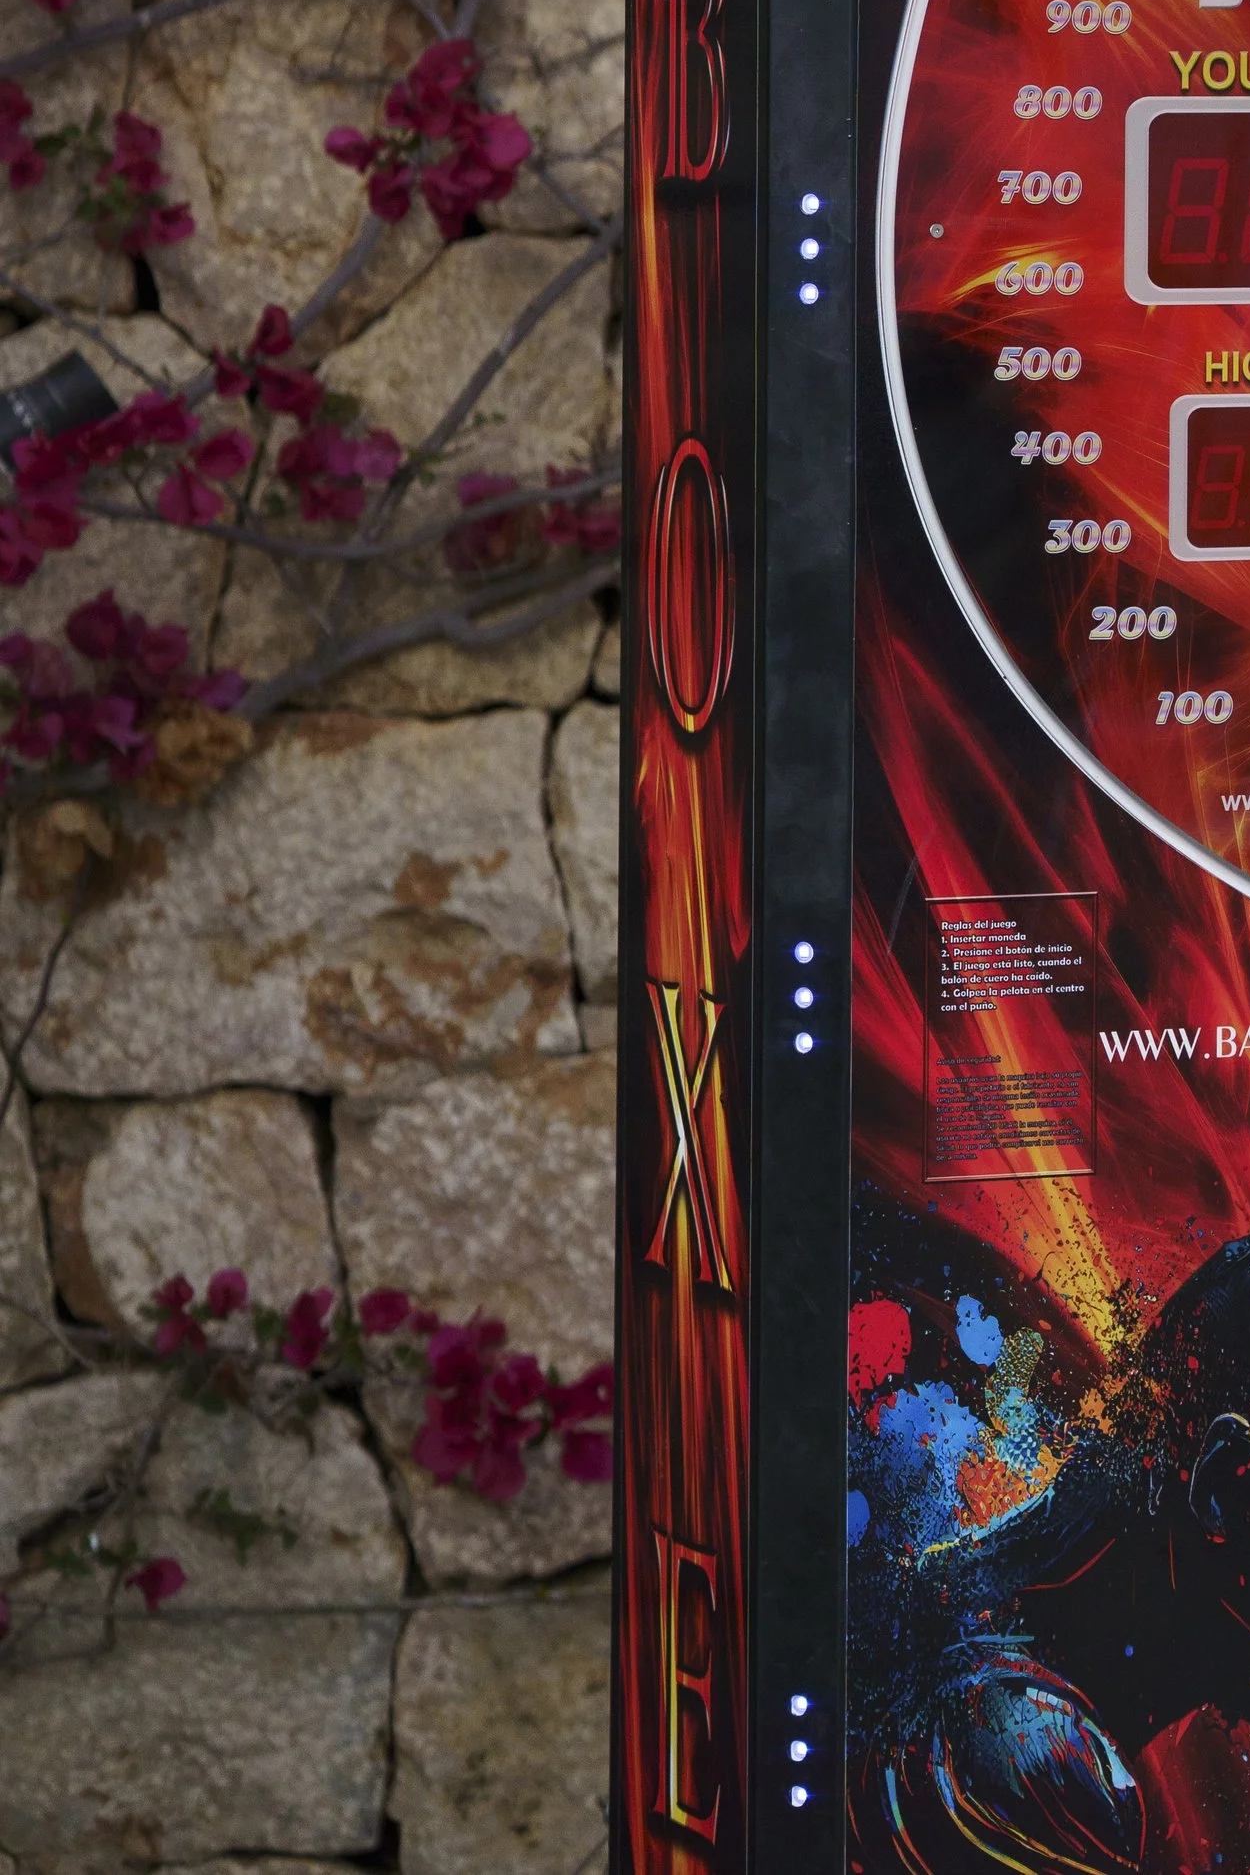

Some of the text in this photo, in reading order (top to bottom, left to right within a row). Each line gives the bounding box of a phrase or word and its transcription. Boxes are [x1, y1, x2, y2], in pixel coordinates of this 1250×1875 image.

[1046, 0, 1132, 34] 900
[1013, 85, 1102, 119] 800
[997, 171, 1082, 204] 700
[995, 261, 1084, 295] 600
[994, 347, 1081, 381] 500
[1011, 431, 1102, 465] 400
[1044, 519, 1131, 554] 300
[1089, 606, 1177, 641] 200
[1155, 690, 1234, 725] 100
[941, 920, 1017, 932] Reglas del juego
[941, 932, 1027, 944] 1. Insertar moneda
[941, 956, 1082, 971] 3. El juego está listo, cuando el
[953, 947, 993, 957] Presione
[994, 946, 1003, 955] el
[1005, 945, 1032, 955] botón
[1034, 944, 1046, 953] de
[1048, 943, 1073, 953] inicio
[941, 971, 1053, 985] balón de cuero ha caído.
[941, 990, 950, 998] 4.
[953, 988, 986, 998] Golpea
[988, 987, 998, 996] la
[1000, 986, 1030, 997] pelota
[1045, 985, 1054, 993] el
[1055, 984, 1085, 993] centro
[941, 1001, 997, 1013] con el puño.
